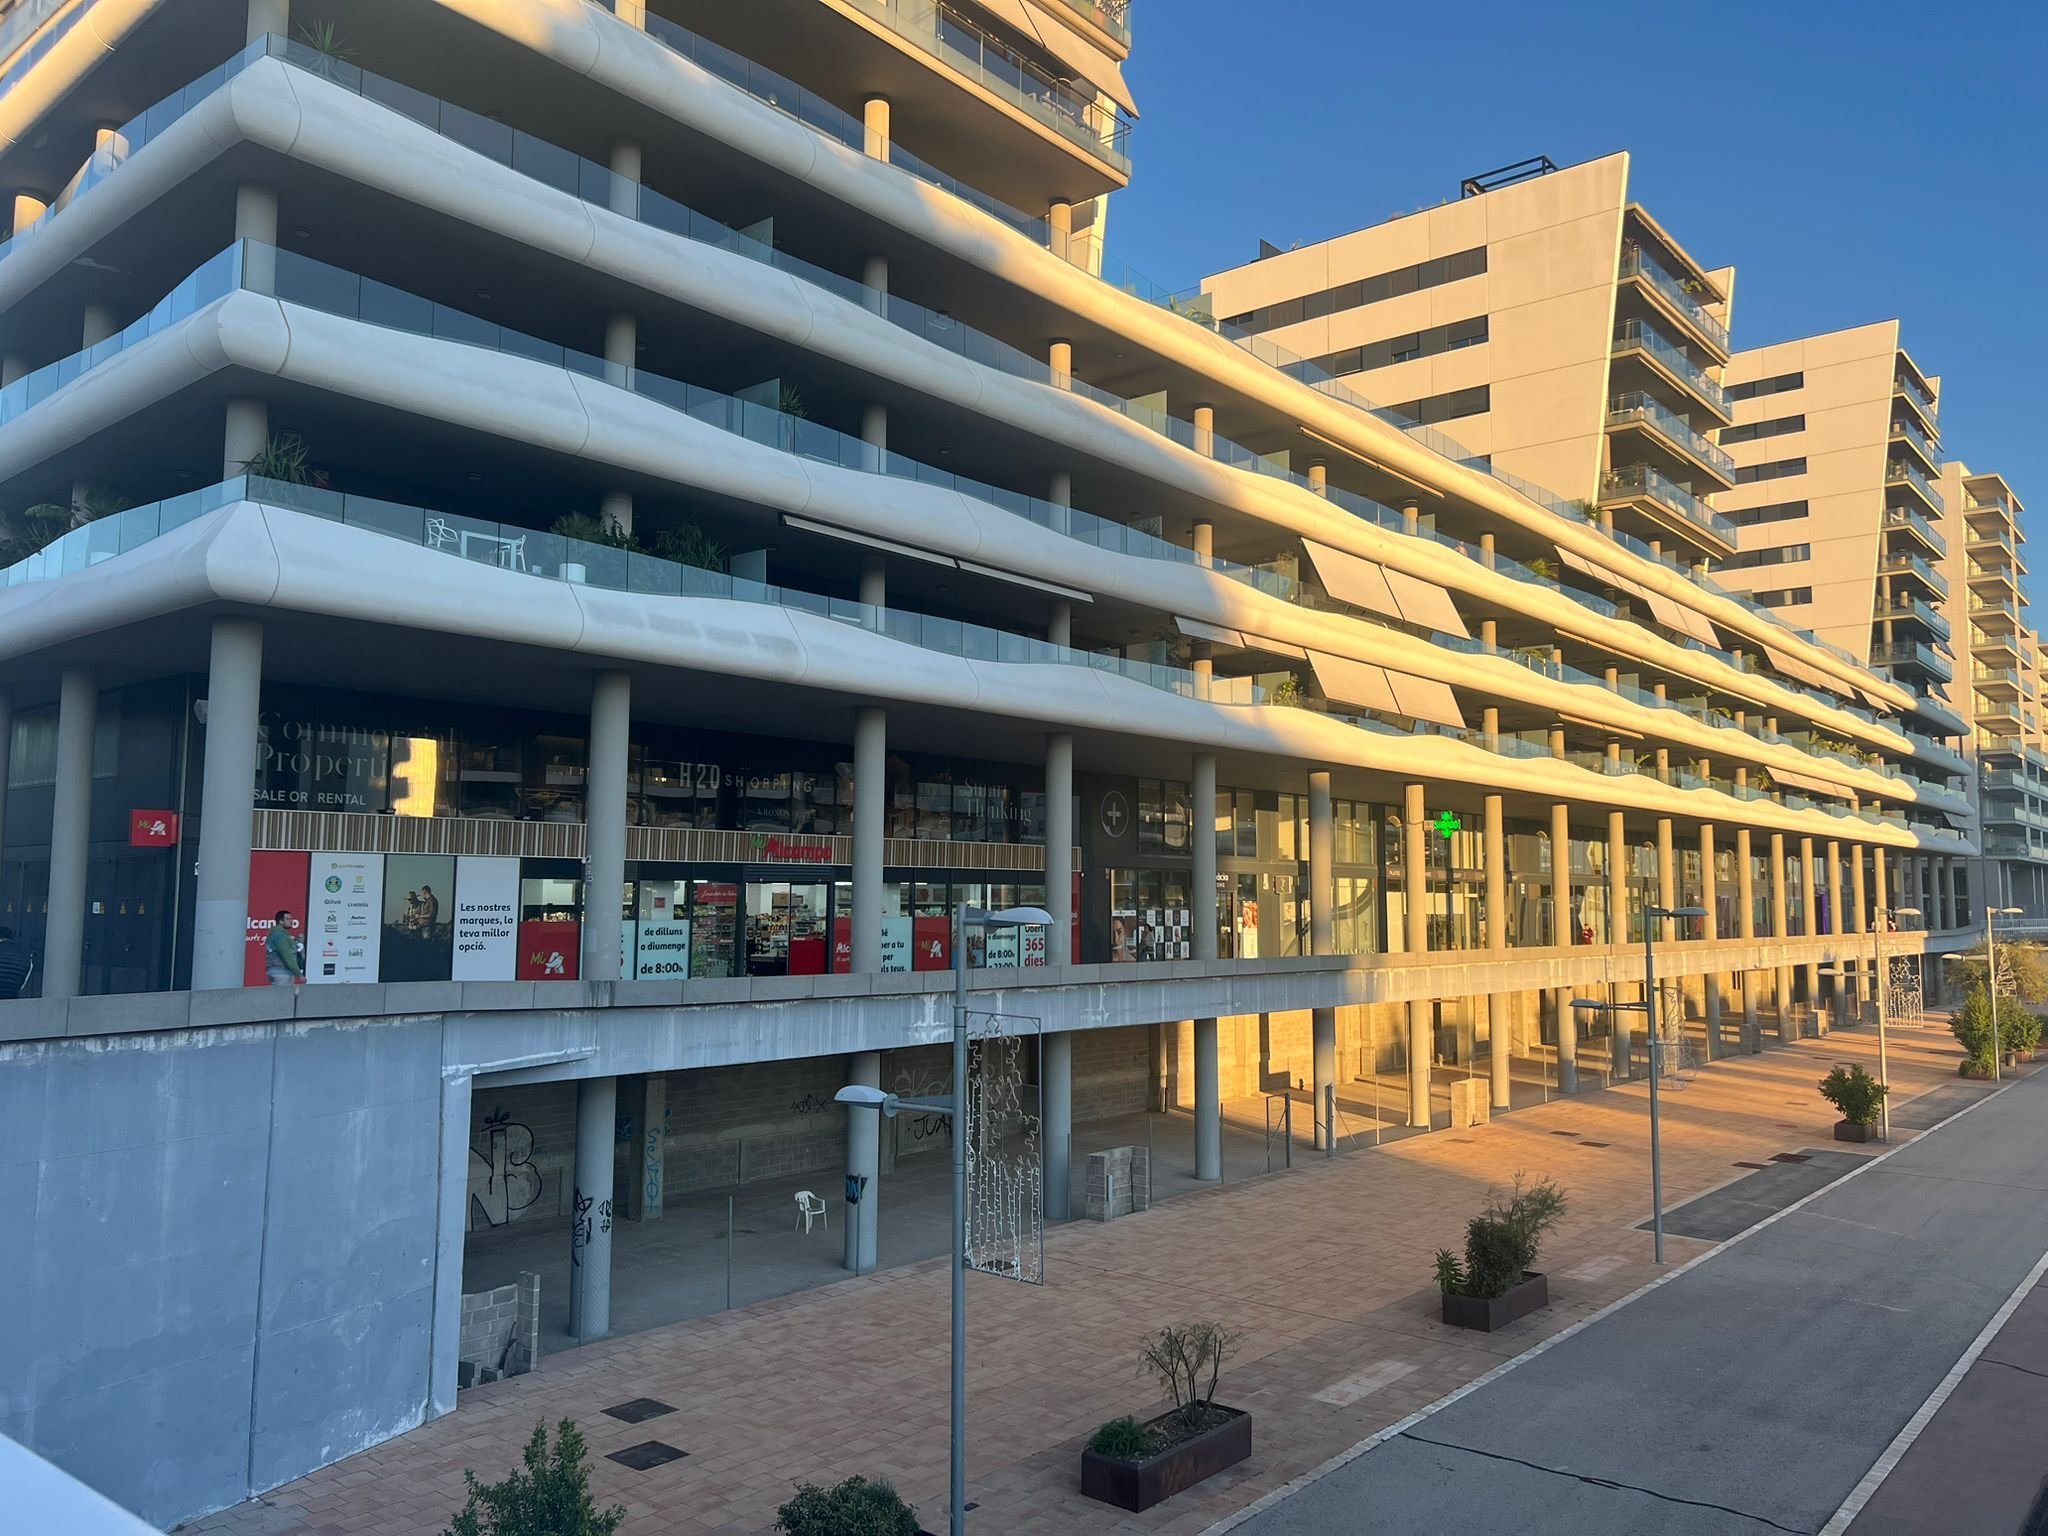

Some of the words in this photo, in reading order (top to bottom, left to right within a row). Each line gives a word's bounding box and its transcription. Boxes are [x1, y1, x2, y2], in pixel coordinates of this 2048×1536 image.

[724, 774, 813, 793] SHOPPING
[253, 788, 286, 802] SALE
[289, 790, 309, 803] OR
[317, 791, 367, 806] RENTAL
[763, 836, 834, 862] Alcampo
[460, 903, 476, 912] Les
[477, 904, 511, 912] nostres
[459, 917, 503, 926] marques,
[504, 916, 513, 924] la
[459, 929, 480, 938] teva
[481, 929, 510, 938] millor
[644, 927, 654, 936] de
[656, 926, 683, 937] dilluns
[458, 941, 486, 952] opció.
[647, 941, 686, 952] diumenge
[1025, 937, 1044, 951] 365
[882, 954, 894, 963] per
[988, 950, 997, 959] de
[1024, 954, 1044, 967] dies
[640, 963, 654, 974] de
[655, 962, 684, 974] 8:00h
